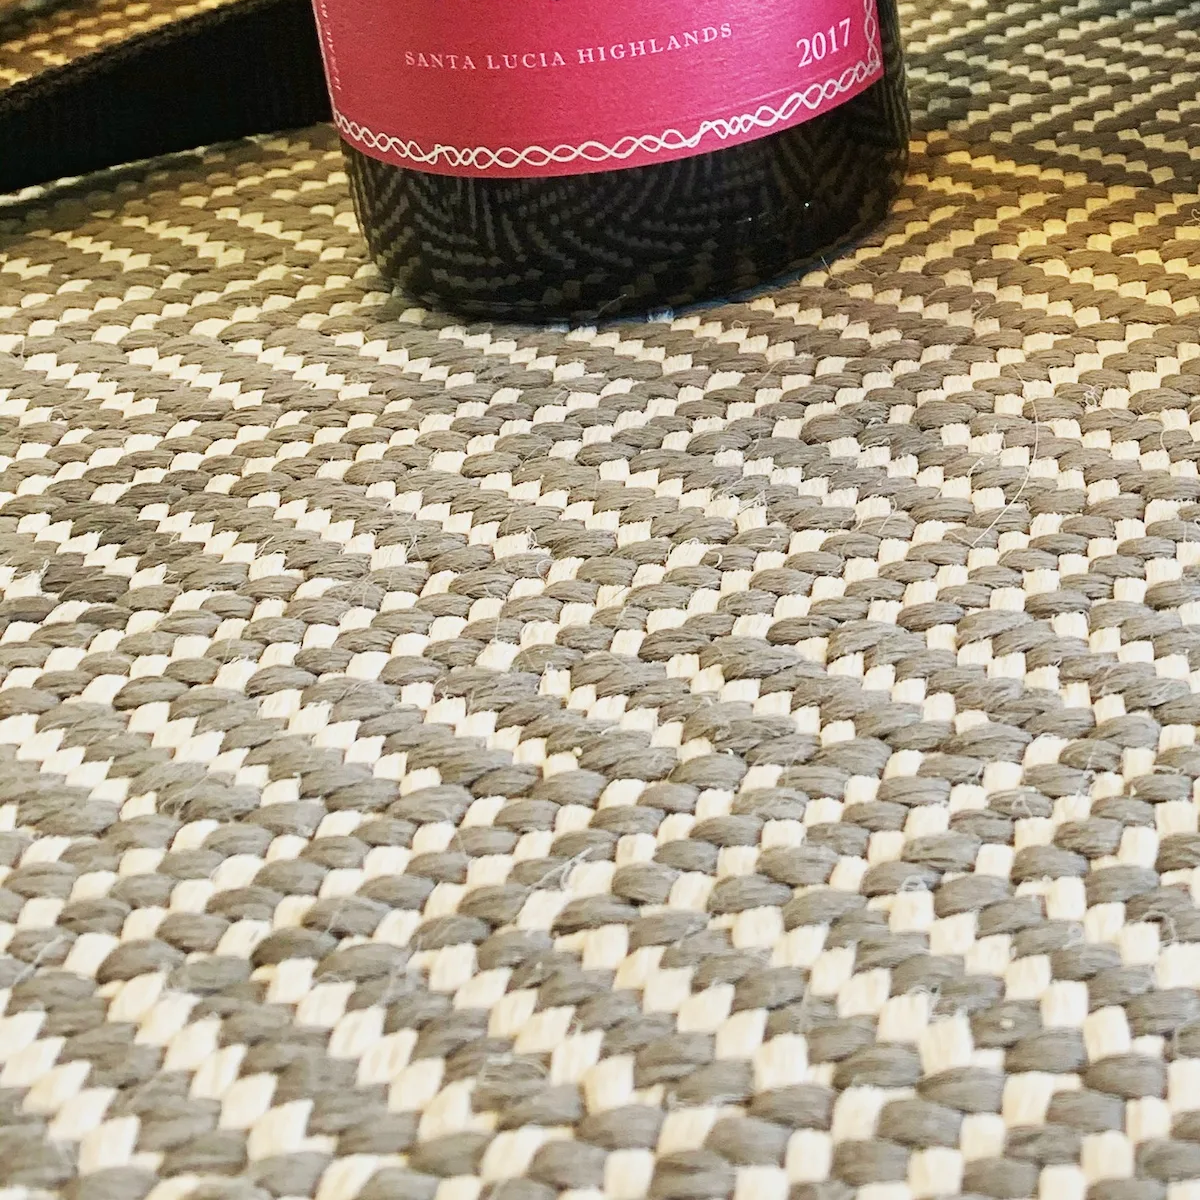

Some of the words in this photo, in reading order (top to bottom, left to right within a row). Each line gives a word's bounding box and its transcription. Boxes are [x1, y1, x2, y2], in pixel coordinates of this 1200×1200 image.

[404, 50, 478, 71] SANTA
[486, 50, 567, 71] LUCIA
[577, 22, 733, 65] HIGHLANDS
[796, 17, 852, 68] 2017
